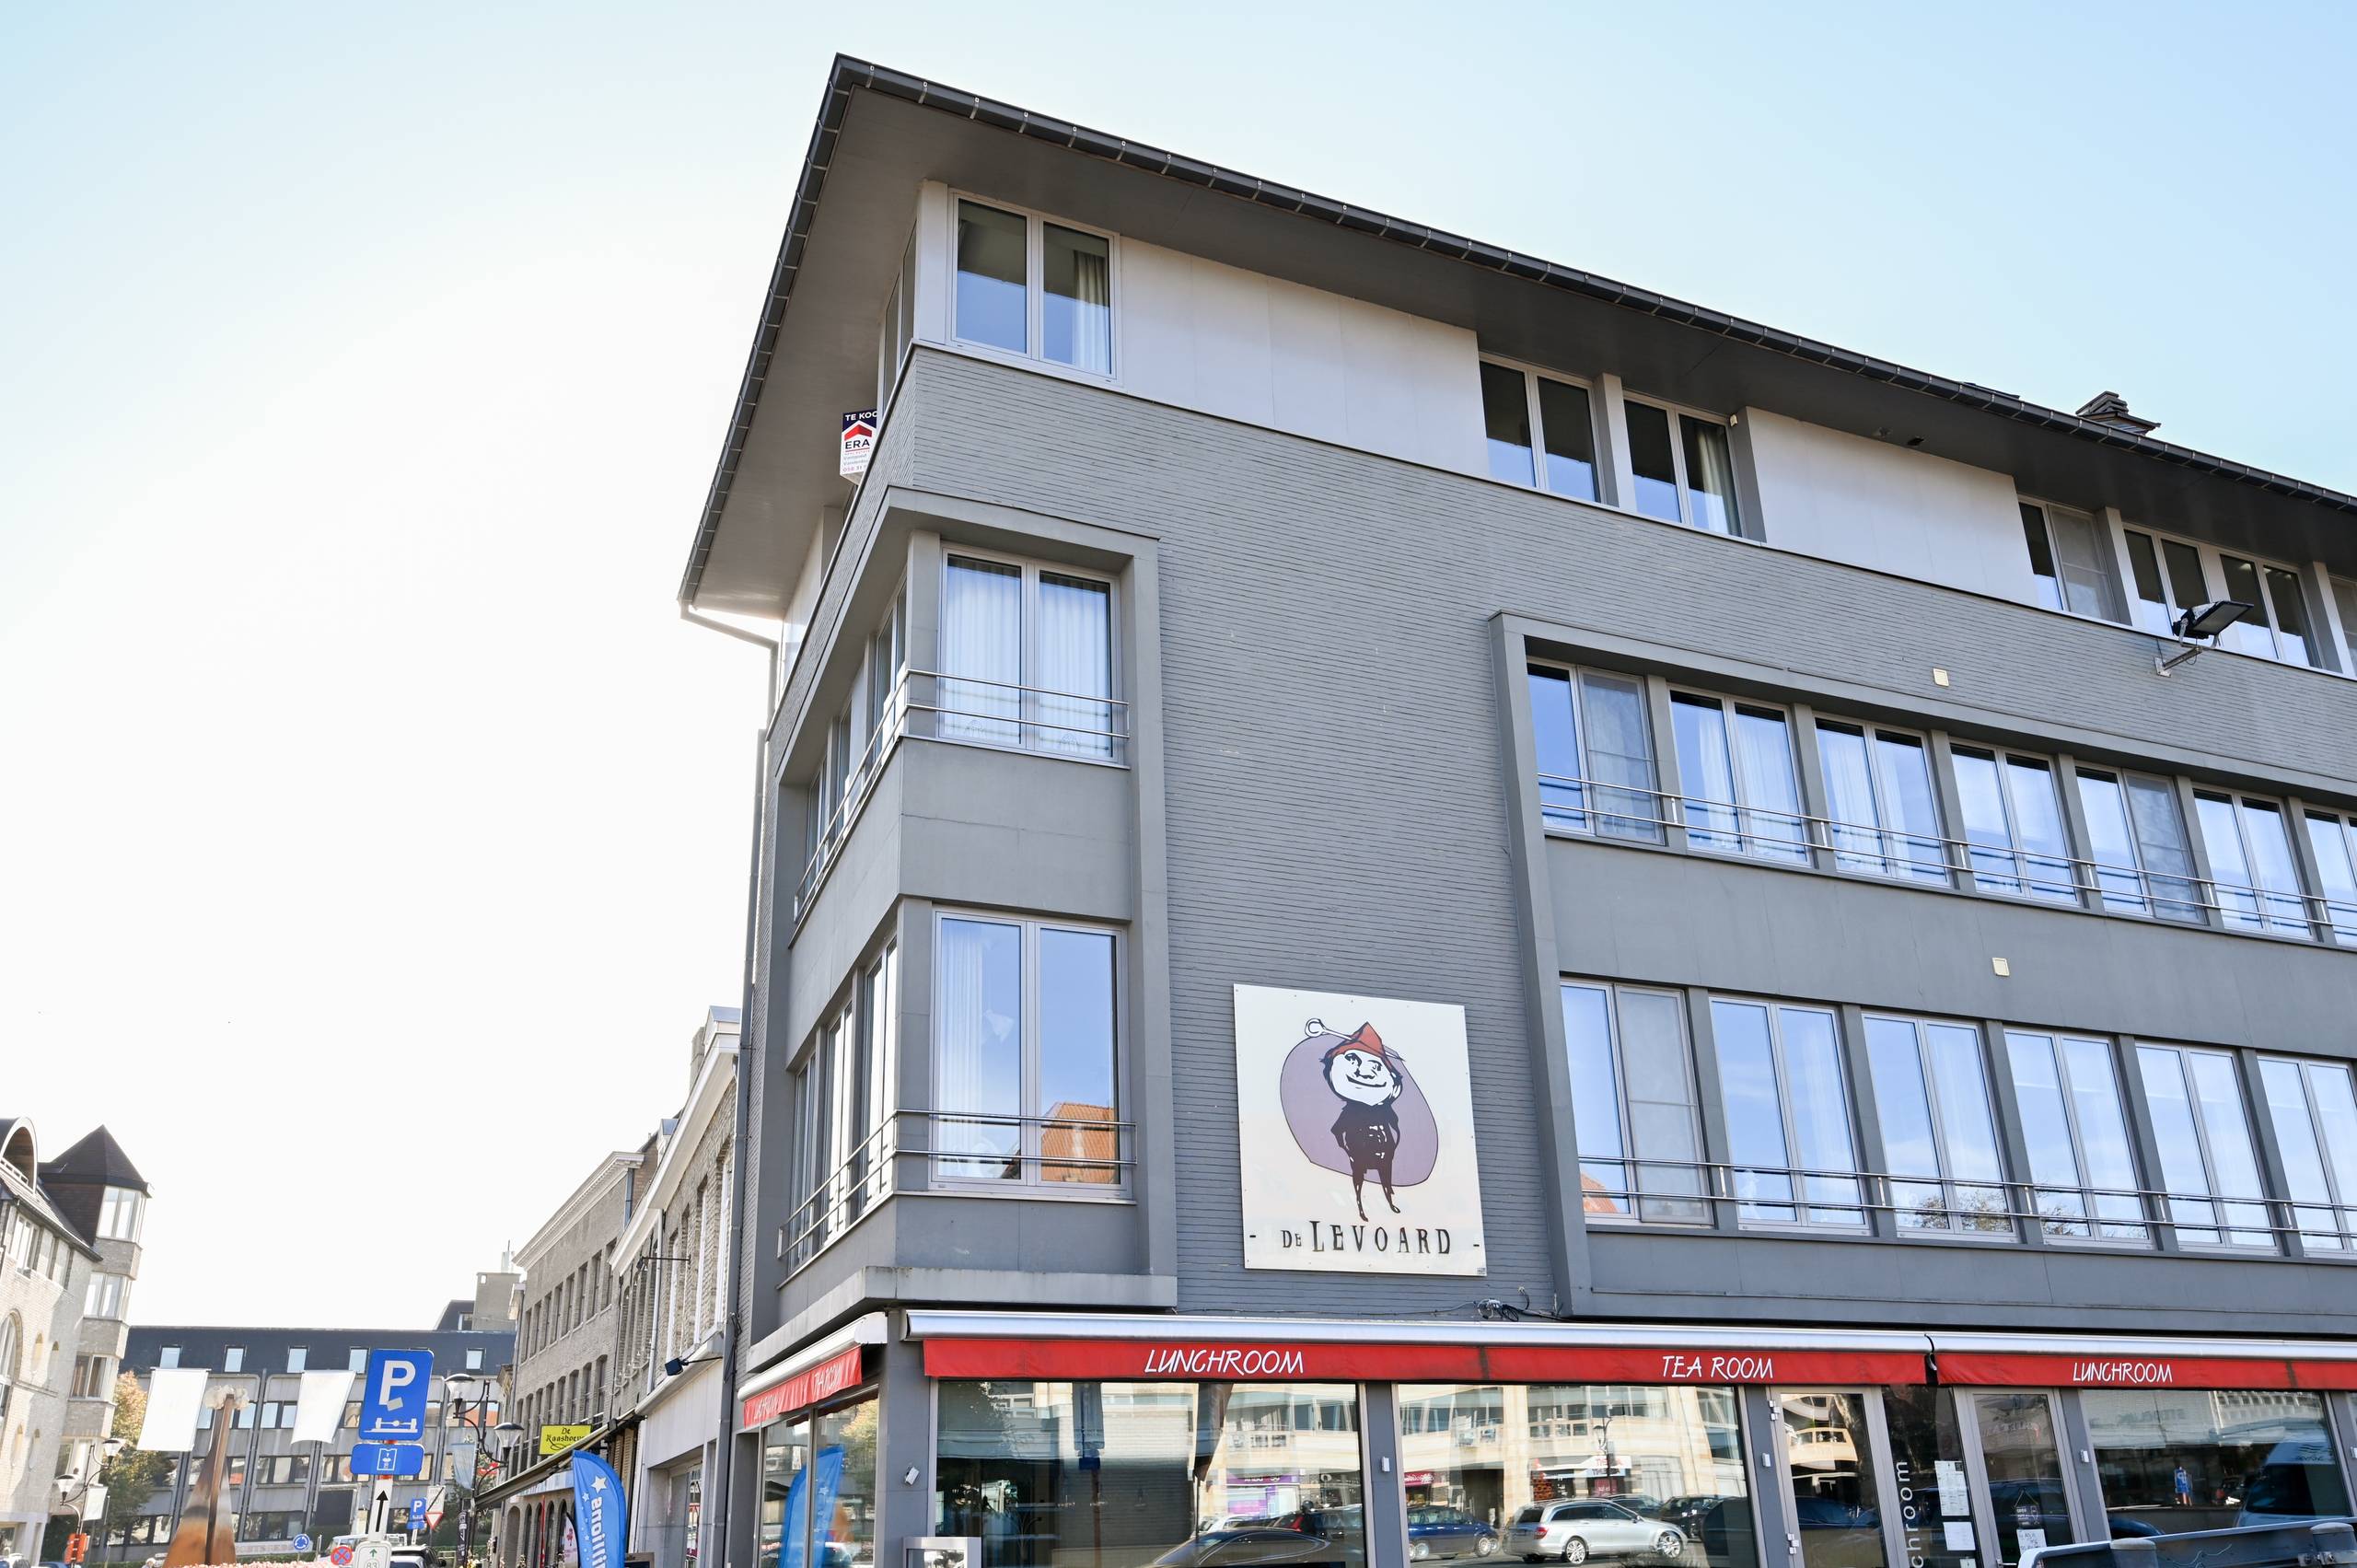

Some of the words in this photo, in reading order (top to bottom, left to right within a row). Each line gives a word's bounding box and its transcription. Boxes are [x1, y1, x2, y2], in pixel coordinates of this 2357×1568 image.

[859, 411, 877, 420] KOO
[845, 438, 870, 449] ERA
[1308, 1220, 1451, 1255] LEVOARD
[1144, 1349, 1304, 1376] LUNCHROOM
[1663, 1355, 1702, 1378] TEA
[1711, 1356, 1774, 1380] ROOM
[2073, 1362, 2173, 1384] LUNCHROOM
[378, 1360, 416, 1406] P
